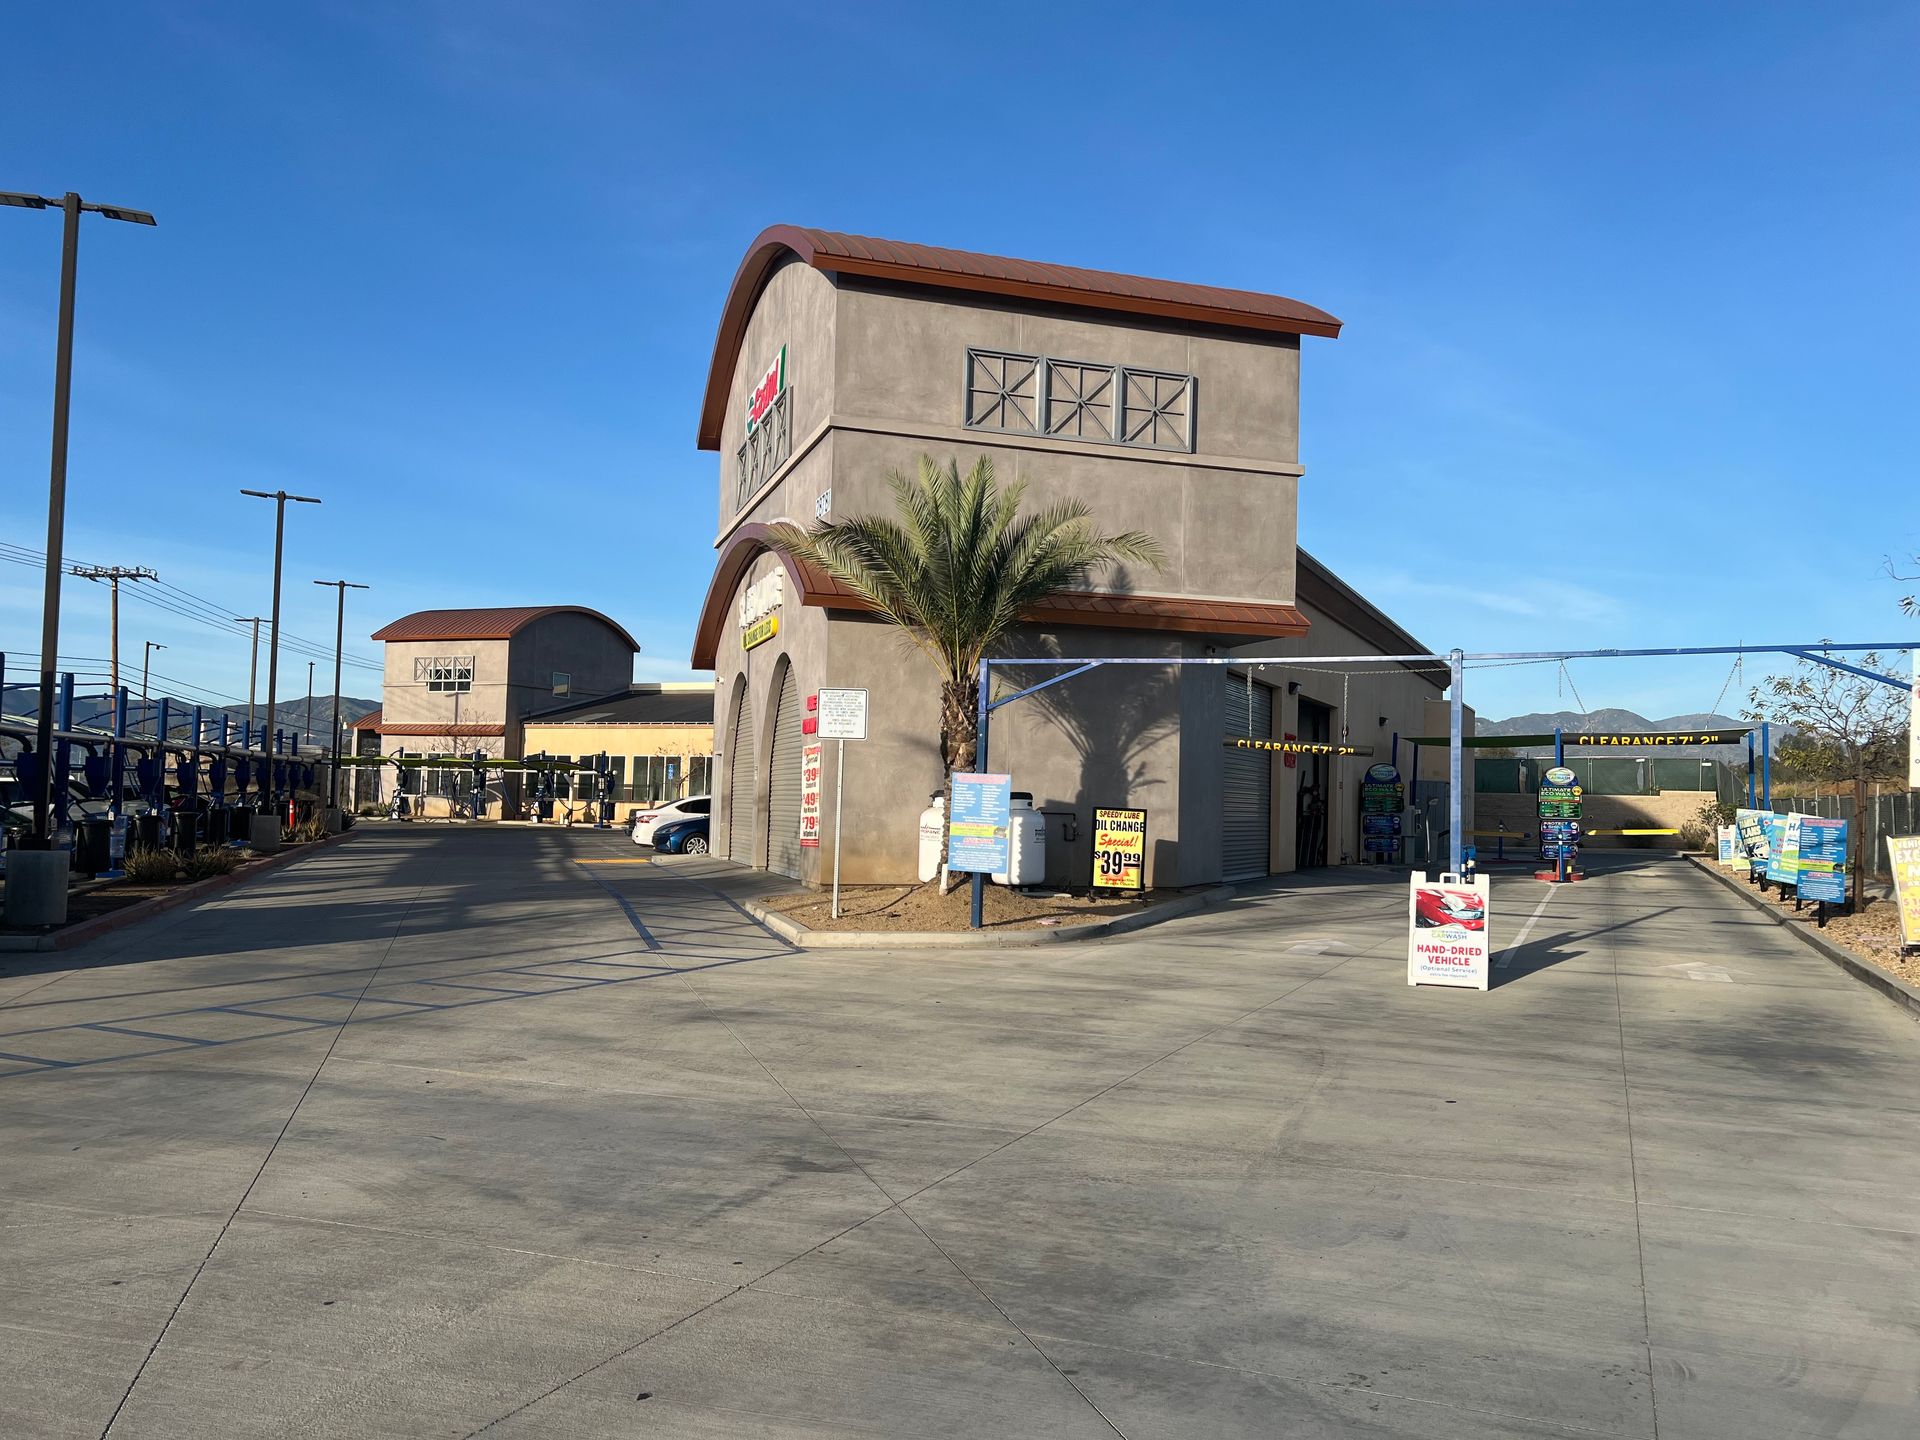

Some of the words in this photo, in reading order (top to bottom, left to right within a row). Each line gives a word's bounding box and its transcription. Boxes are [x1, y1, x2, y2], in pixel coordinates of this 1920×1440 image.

[1580, 735, 1675, 745] CLEARANCE
[1237, 739, 1319, 753] CLEARANCE
[1099, 810, 1123, 819] SPEEDY
[1124, 812, 1140, 820] LUBE
[1096, 819, 1108, 831] OIL
[1110, 820, 1145, 833] CHANGE
[1099, 833, 1139, 848] Special!
[1417, 944, 1482, 956] HAND-DRIED
[1428, 955, 1470, 966] VEHICLE
[1452, 966, 1477, 974] Service)
